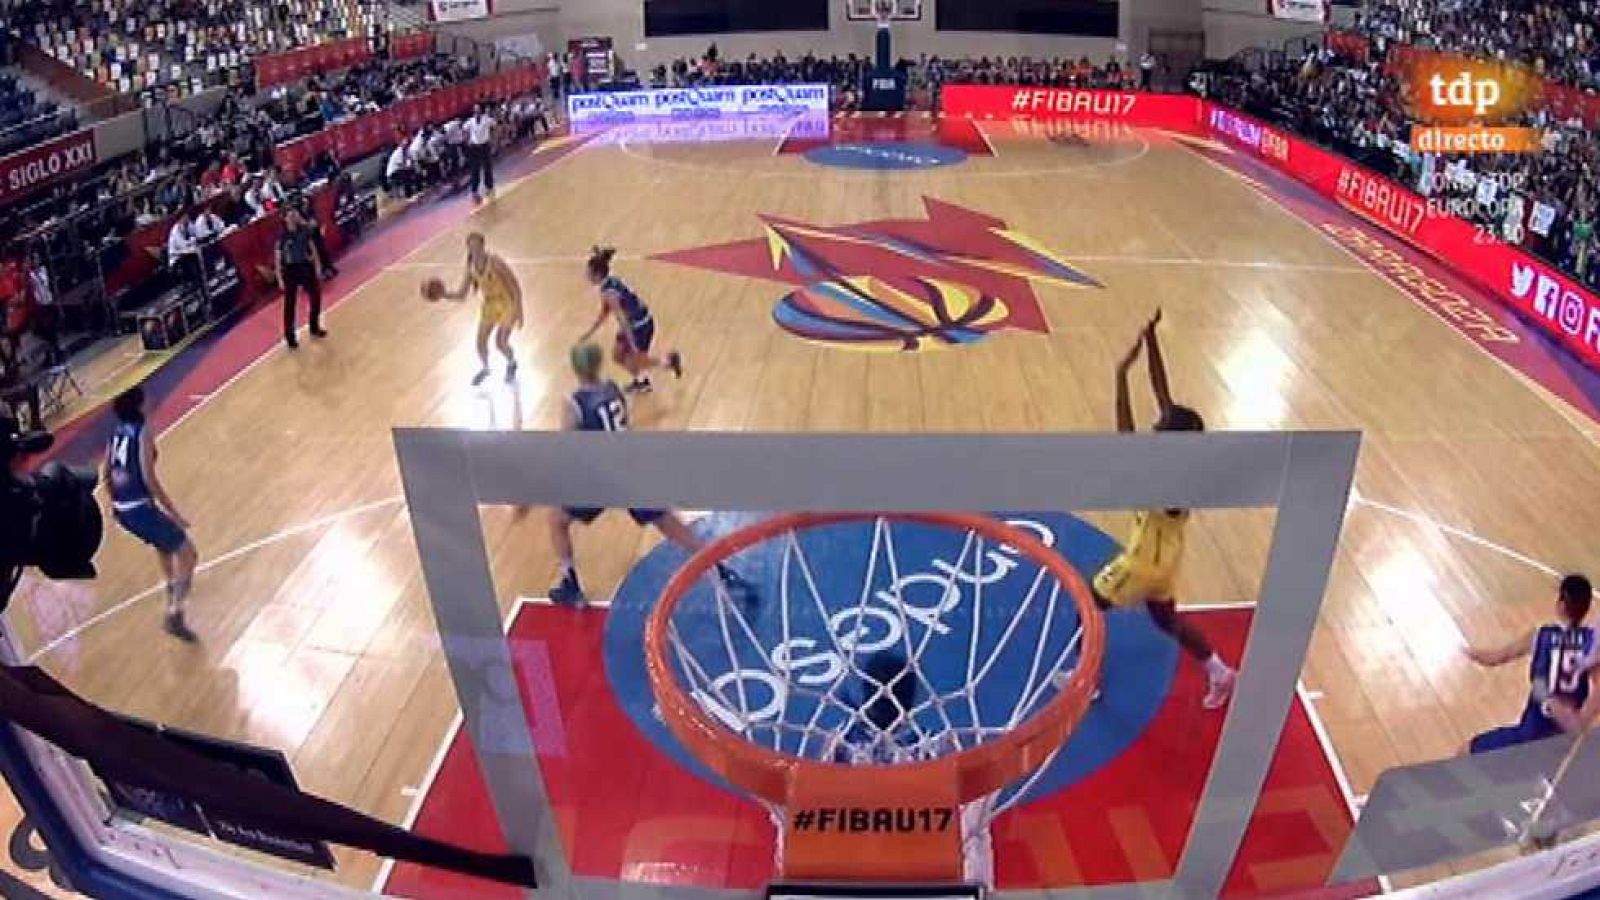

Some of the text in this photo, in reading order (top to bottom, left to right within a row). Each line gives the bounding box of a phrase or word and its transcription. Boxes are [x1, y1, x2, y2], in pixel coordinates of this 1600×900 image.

[1012, 89, 1137, 115] #FIBAU17
[8, 140, 92, 191] SIGLO XXI
[1336, 166, 1425, 233] #FIBAU17
[794, 807, 953, 832] #FIBAU17
